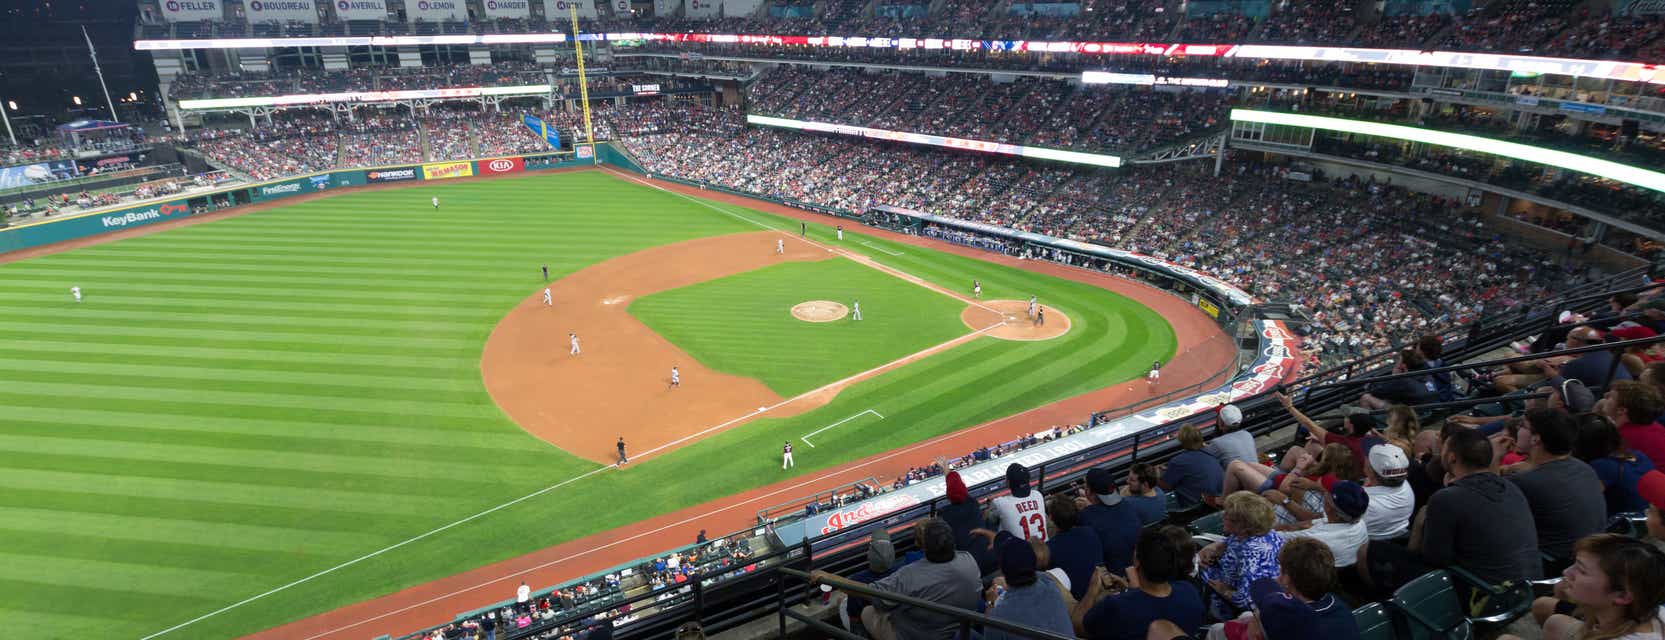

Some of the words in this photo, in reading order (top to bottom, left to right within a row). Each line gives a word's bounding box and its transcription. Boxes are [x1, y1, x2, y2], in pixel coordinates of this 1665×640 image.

[180, 1, 215, 10] FELLER
[264, 1, 309, 10] BOUDREAU
[350, 1, 384, 10] AVERILL
[428, 1, 455, 9] LEMON
[497, 1, 526, 9] HARDER
[493, 161, 510, 169] KIA
[102, 209, 160, 227] KeyBank
[1015, 500, 1038, 513] REED
[820, 494, 918, 534] Indians
[1019, 513, 1047, 543] 13
